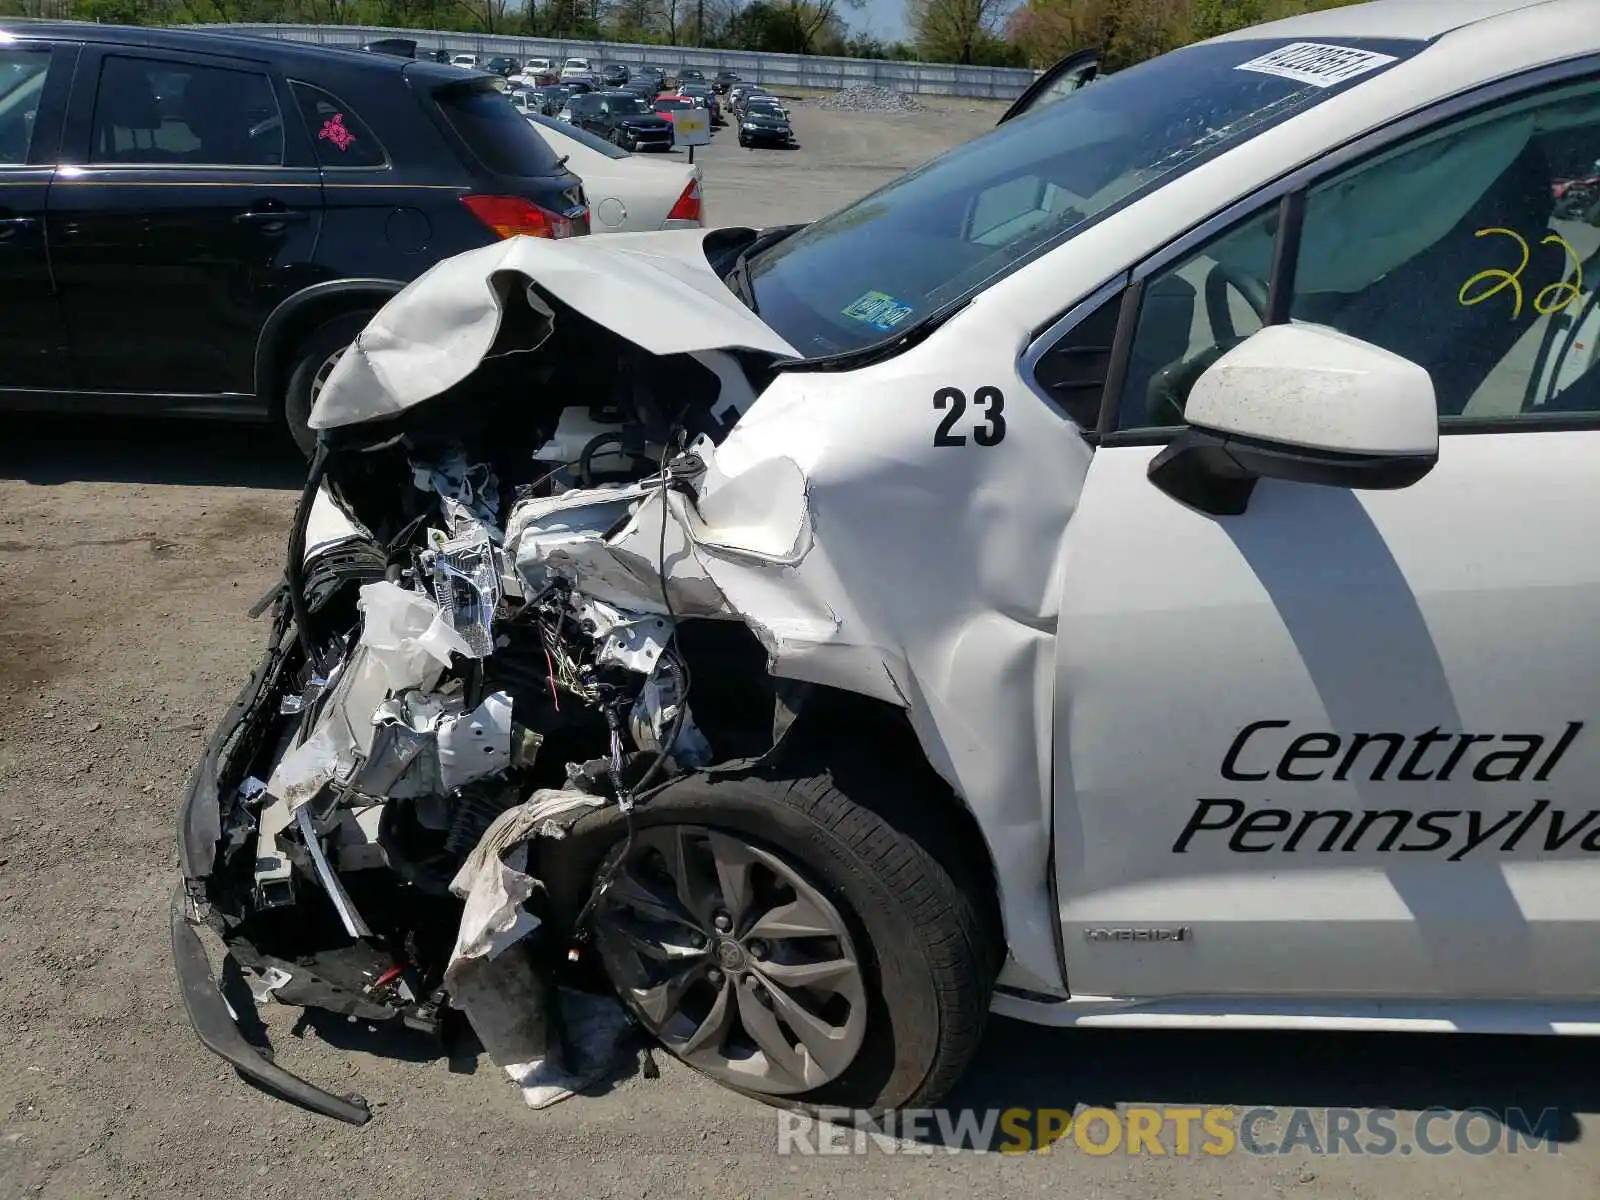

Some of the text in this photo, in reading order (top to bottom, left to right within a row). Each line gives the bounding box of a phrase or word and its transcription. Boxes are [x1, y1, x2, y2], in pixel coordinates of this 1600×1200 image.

[1459, 227, 1582, 320] 22
[933, 386, 1006, 447] 23
[1220, 720, 1583, 781] Central
